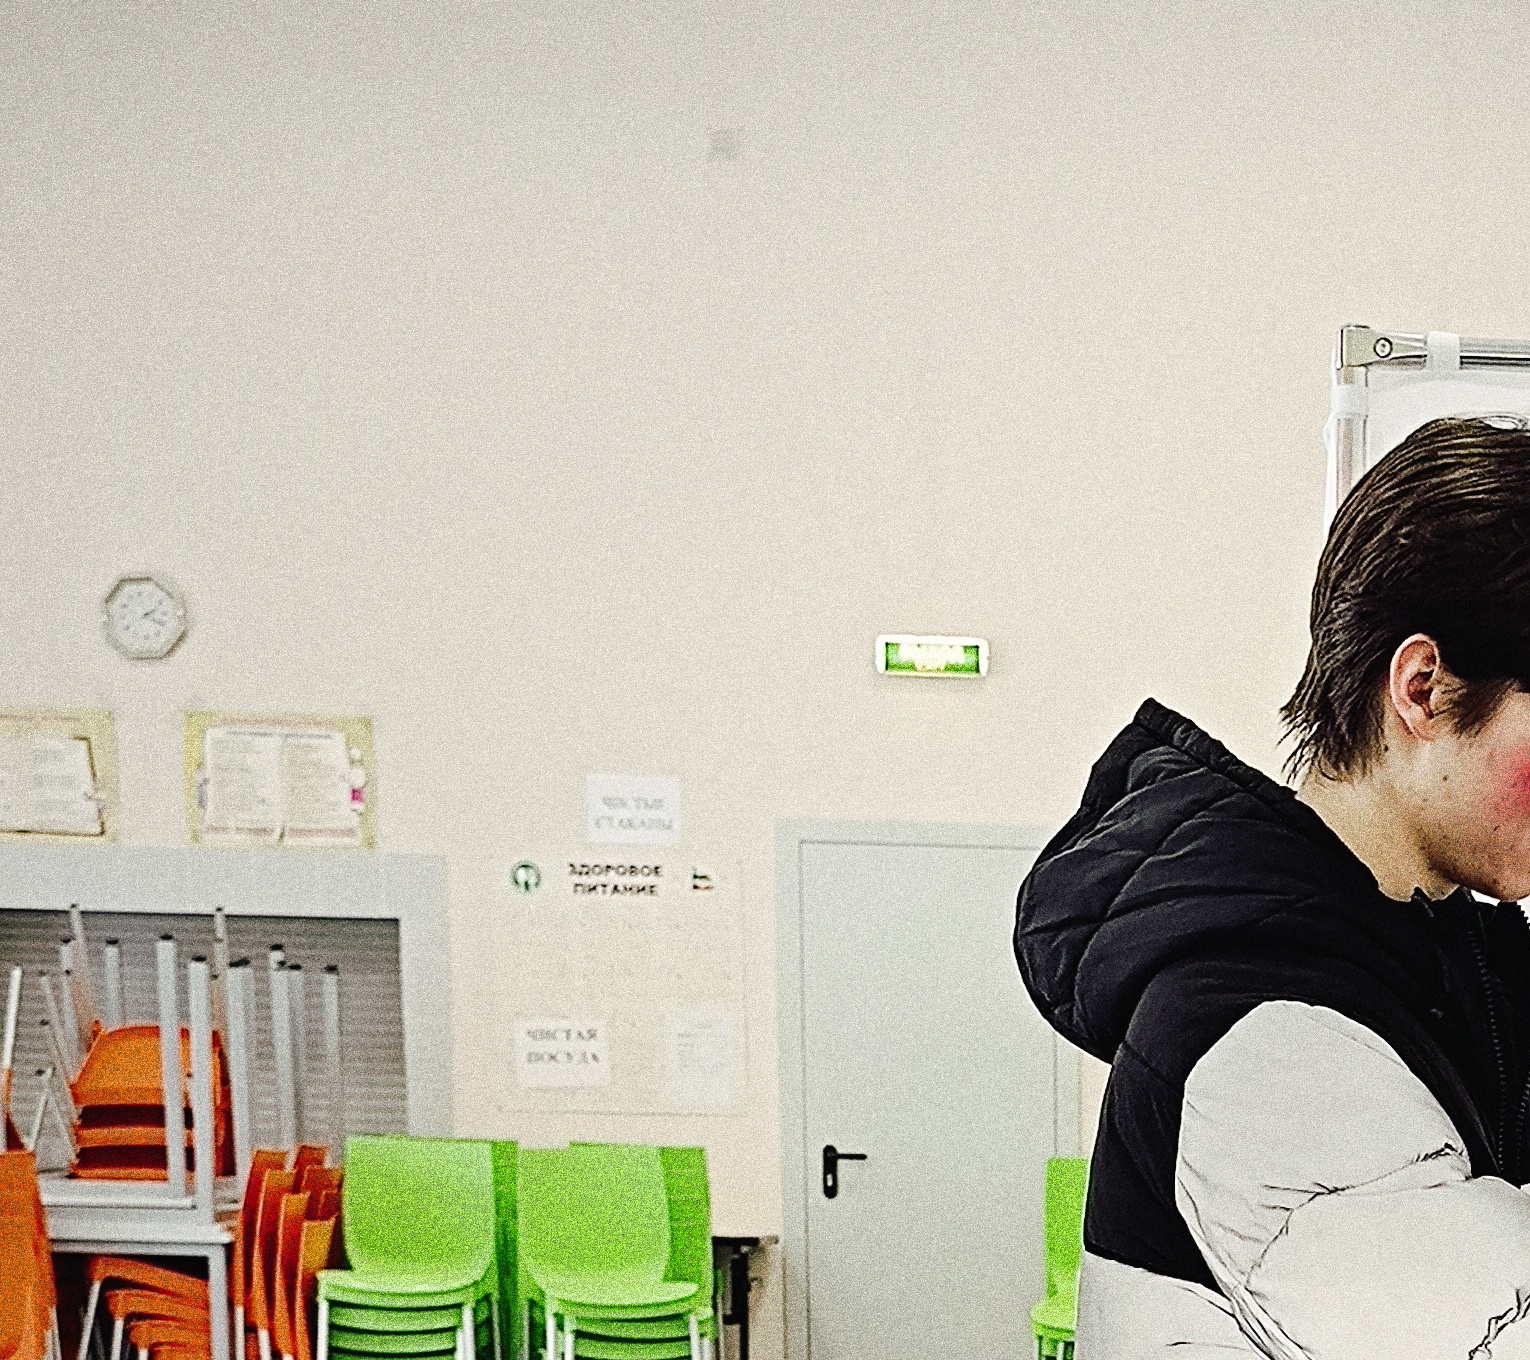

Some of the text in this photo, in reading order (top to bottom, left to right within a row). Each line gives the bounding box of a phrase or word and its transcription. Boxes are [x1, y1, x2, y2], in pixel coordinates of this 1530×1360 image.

[568, 863, 663, 877] ЗДОРОВОЕ
[573, 882, 658, 896] ПИТАНИЕ
[527, 1028, 598, 1041] ЧИСТАЯ
